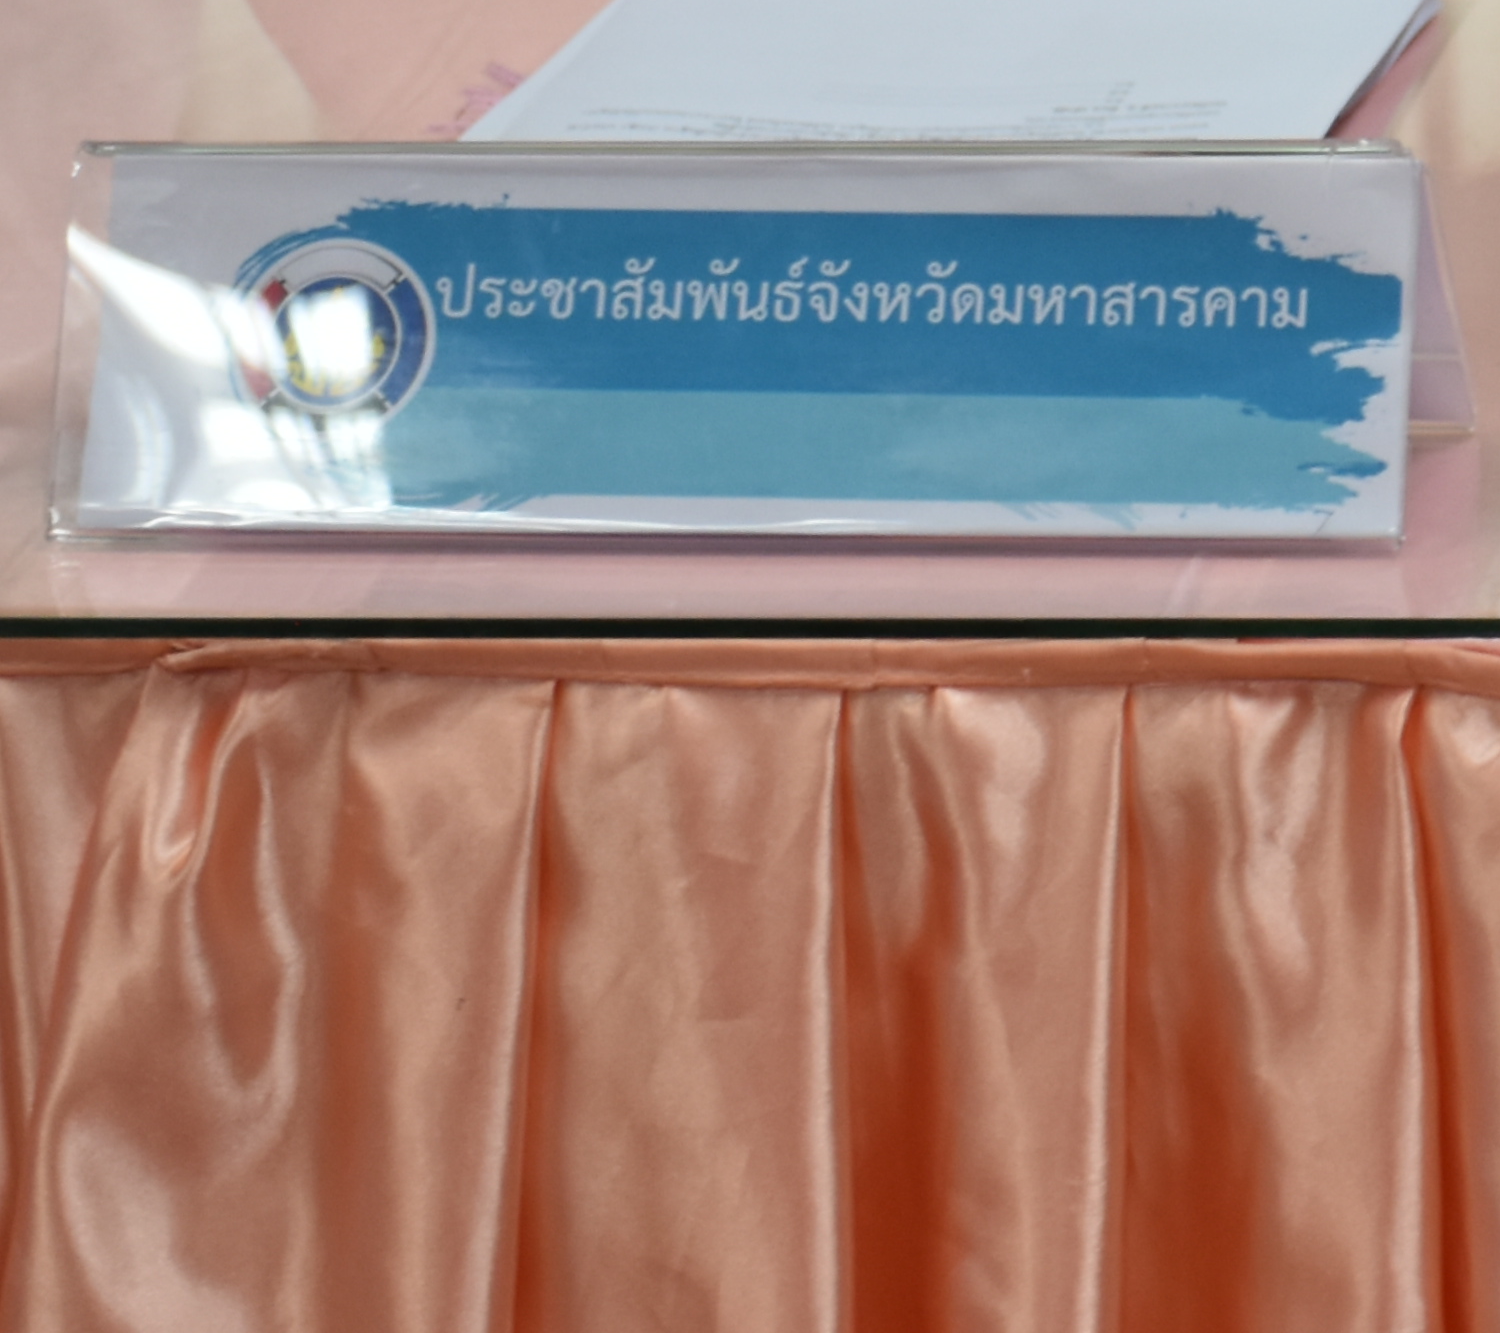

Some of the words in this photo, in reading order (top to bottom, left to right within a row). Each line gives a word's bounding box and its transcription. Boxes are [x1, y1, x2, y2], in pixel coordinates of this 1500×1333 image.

[435, 255, 1310, 330] ประชาสัมพันธ์จังหวัดมหาสารคาม
